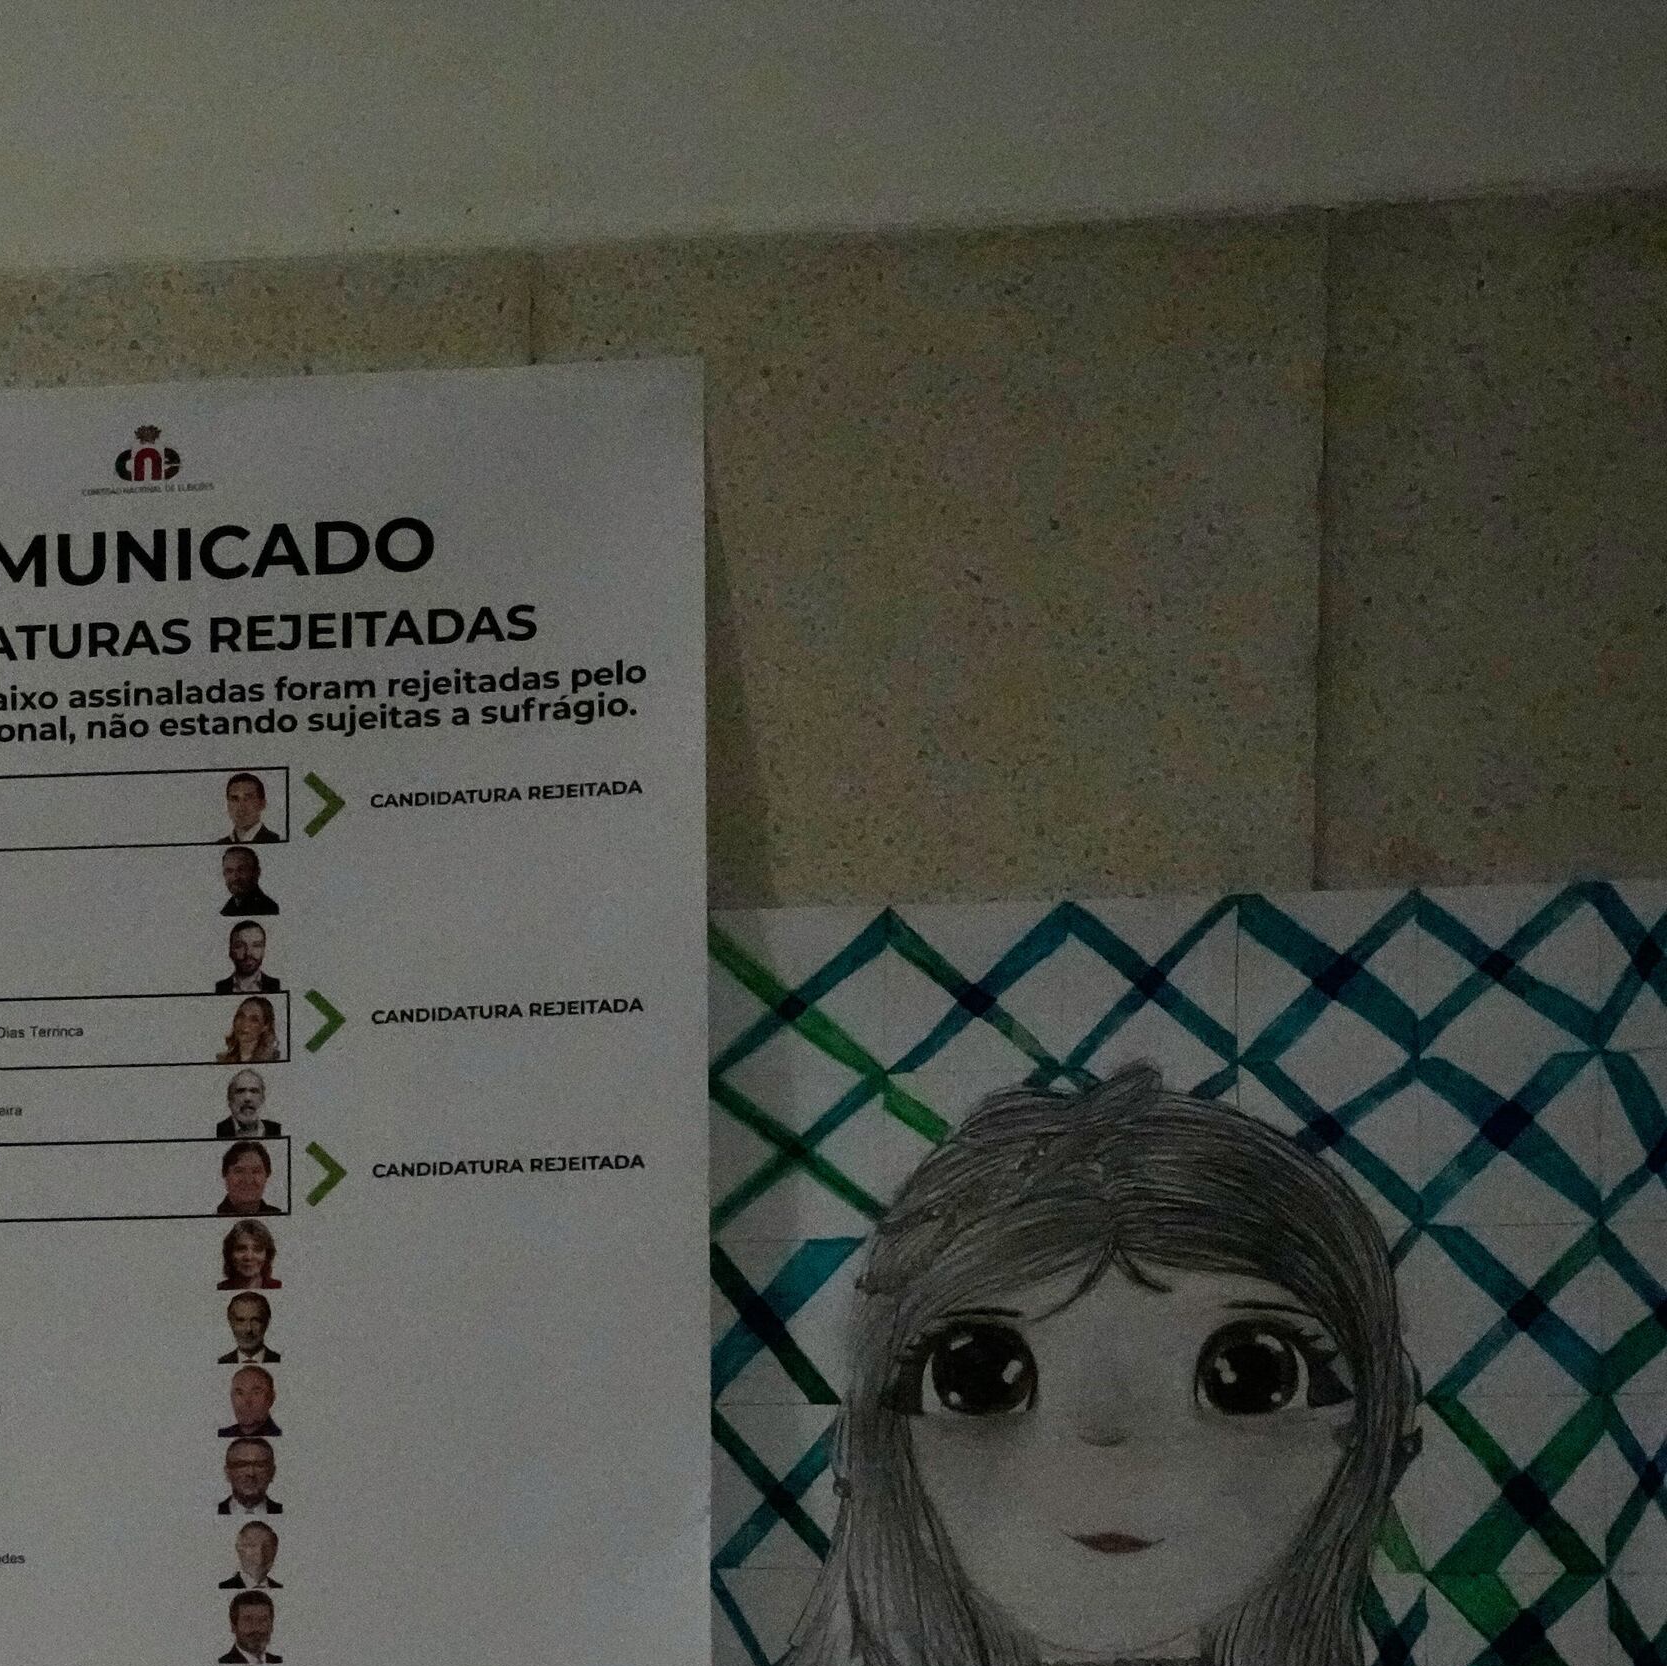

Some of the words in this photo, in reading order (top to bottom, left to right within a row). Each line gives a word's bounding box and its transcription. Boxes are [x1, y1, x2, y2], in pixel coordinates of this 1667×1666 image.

[209, 603, 538, 654] REJEITADAS
[68, 679, 265, 709] assinaladas
[275, 676, 376, 703] foram
[388, 666, 560, 703] rejeitadas
[571, 660, 647, 694] pelo
[88, 715, 149, 741] não
[159, 709, 298, 738] estando
[308, 704, 441, 737] sujeitas
[451, 705, 471, 726] a
[481, 691, 637, 726] sufrágio.
[369, 785, 523, 811] CANDIDATURA
[527, 778, 644, 802] REJEITADA
[370, 1002, 524, 1027] CANDIDATURA
[528, 996, 645, 1019] REJEITADA
[371, 1157, 525, 1180] CANDIDATURA
[529, 1152, 646, 1174] REJEITADA
